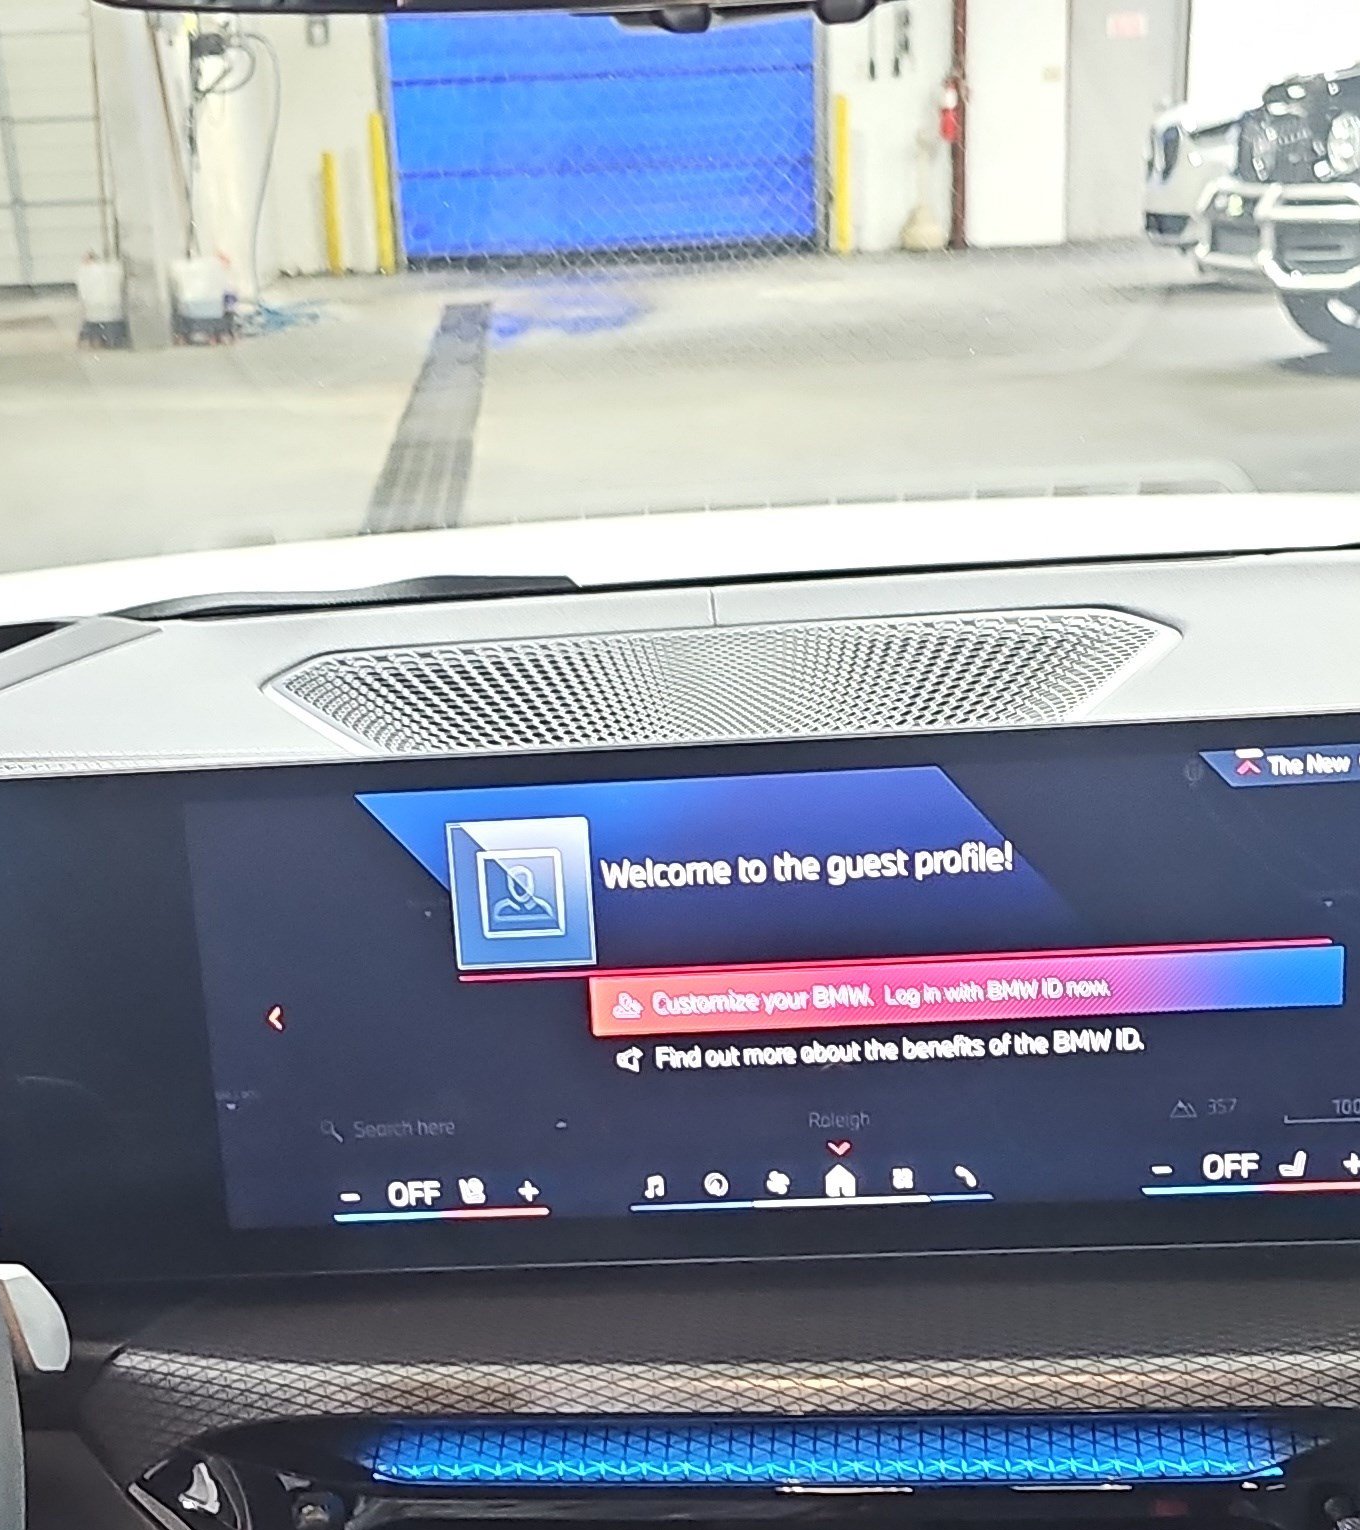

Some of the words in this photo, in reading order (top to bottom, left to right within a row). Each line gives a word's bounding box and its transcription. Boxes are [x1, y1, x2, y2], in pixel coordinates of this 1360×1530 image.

[1267, 755, 1303, 777] The
[1306, 752, 1351, 774] New
[600, 853, 731, 890] Welcome
[738, 854, 768, 884] to
[773, 850, 821, 882] the
[826, 847, 910, 887] guest
[914, 840, 1014, 882] profile!
[651, 988, 760, 1018] Customize
[761, 990, 809, 1021] your
[883, 983, 921, 1009] Log
[922, 983, 942, 1004] in
[943, 980, 985, 1004] with
[986, 977, 1039, 1002] BMW
[1041, 976, 1065, 1000] ID
[654, 1043, 711, 1070] Find
[712, 1043, 741, 1068] out
[742, 1045, 797, 1067] more
[799, 1036, 862, 1065] about
[863, 1037, 901, 1063] the
[901, 1034, 986, 1061] benefits
[988, 1032, 1012, 1057] of
[1013, 1031, 1049, 1056] the
[1052, 1027, 1113, 1054] BMW
[1115, 1026, 1145, 1052] ID.
[351, 1119, 414, 1140] Search
[416, 1118, 456, 1138] here
[807, 1111, 871, 1132] Raleigh
[1201, 1152, 1261, 1181] OFF
[386, 1179, 442, 1208] OFF
